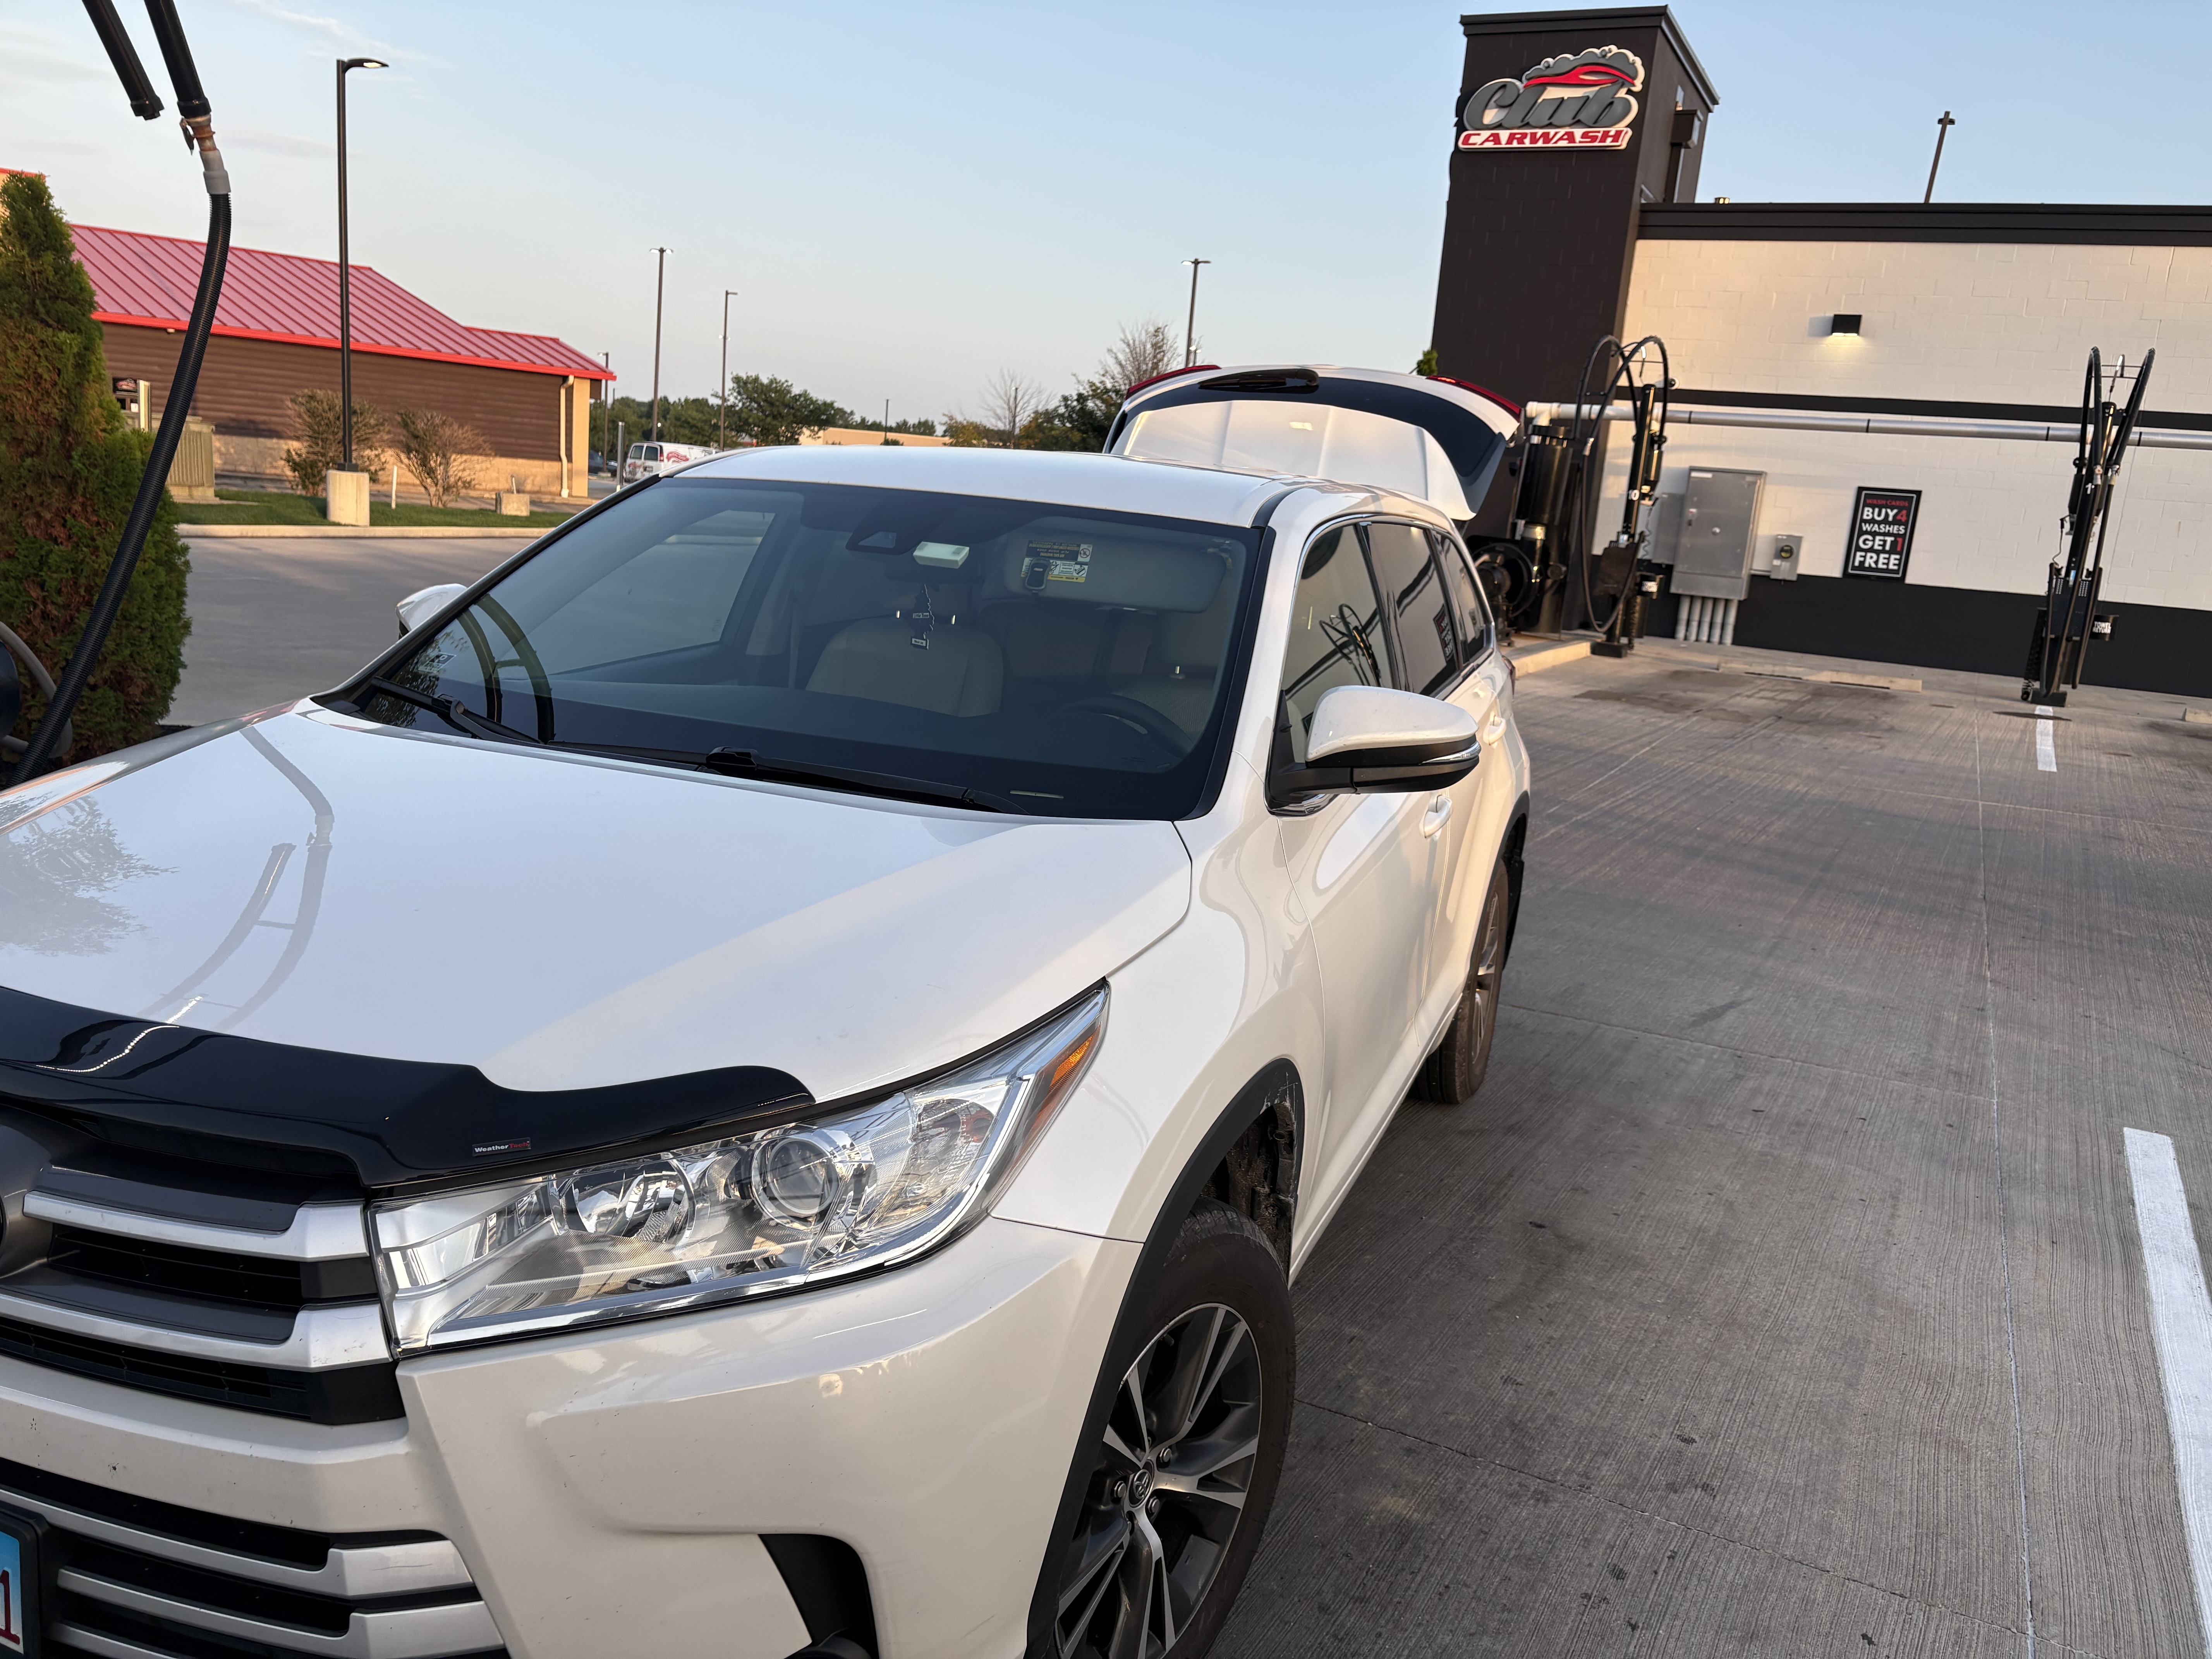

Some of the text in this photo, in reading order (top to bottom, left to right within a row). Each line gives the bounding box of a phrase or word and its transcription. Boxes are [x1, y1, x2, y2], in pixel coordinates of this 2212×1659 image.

[1466, 80, 1632, 129] Club
[1461, 129, 1625, 146] CARWASH
[1863, 507, 1907, 522] BUY 4
[1862, 522, 1905, 534] WASHES
[1859, 534, 1903, 551] GET 1
[1854, 551, 1900, 570] FREE
